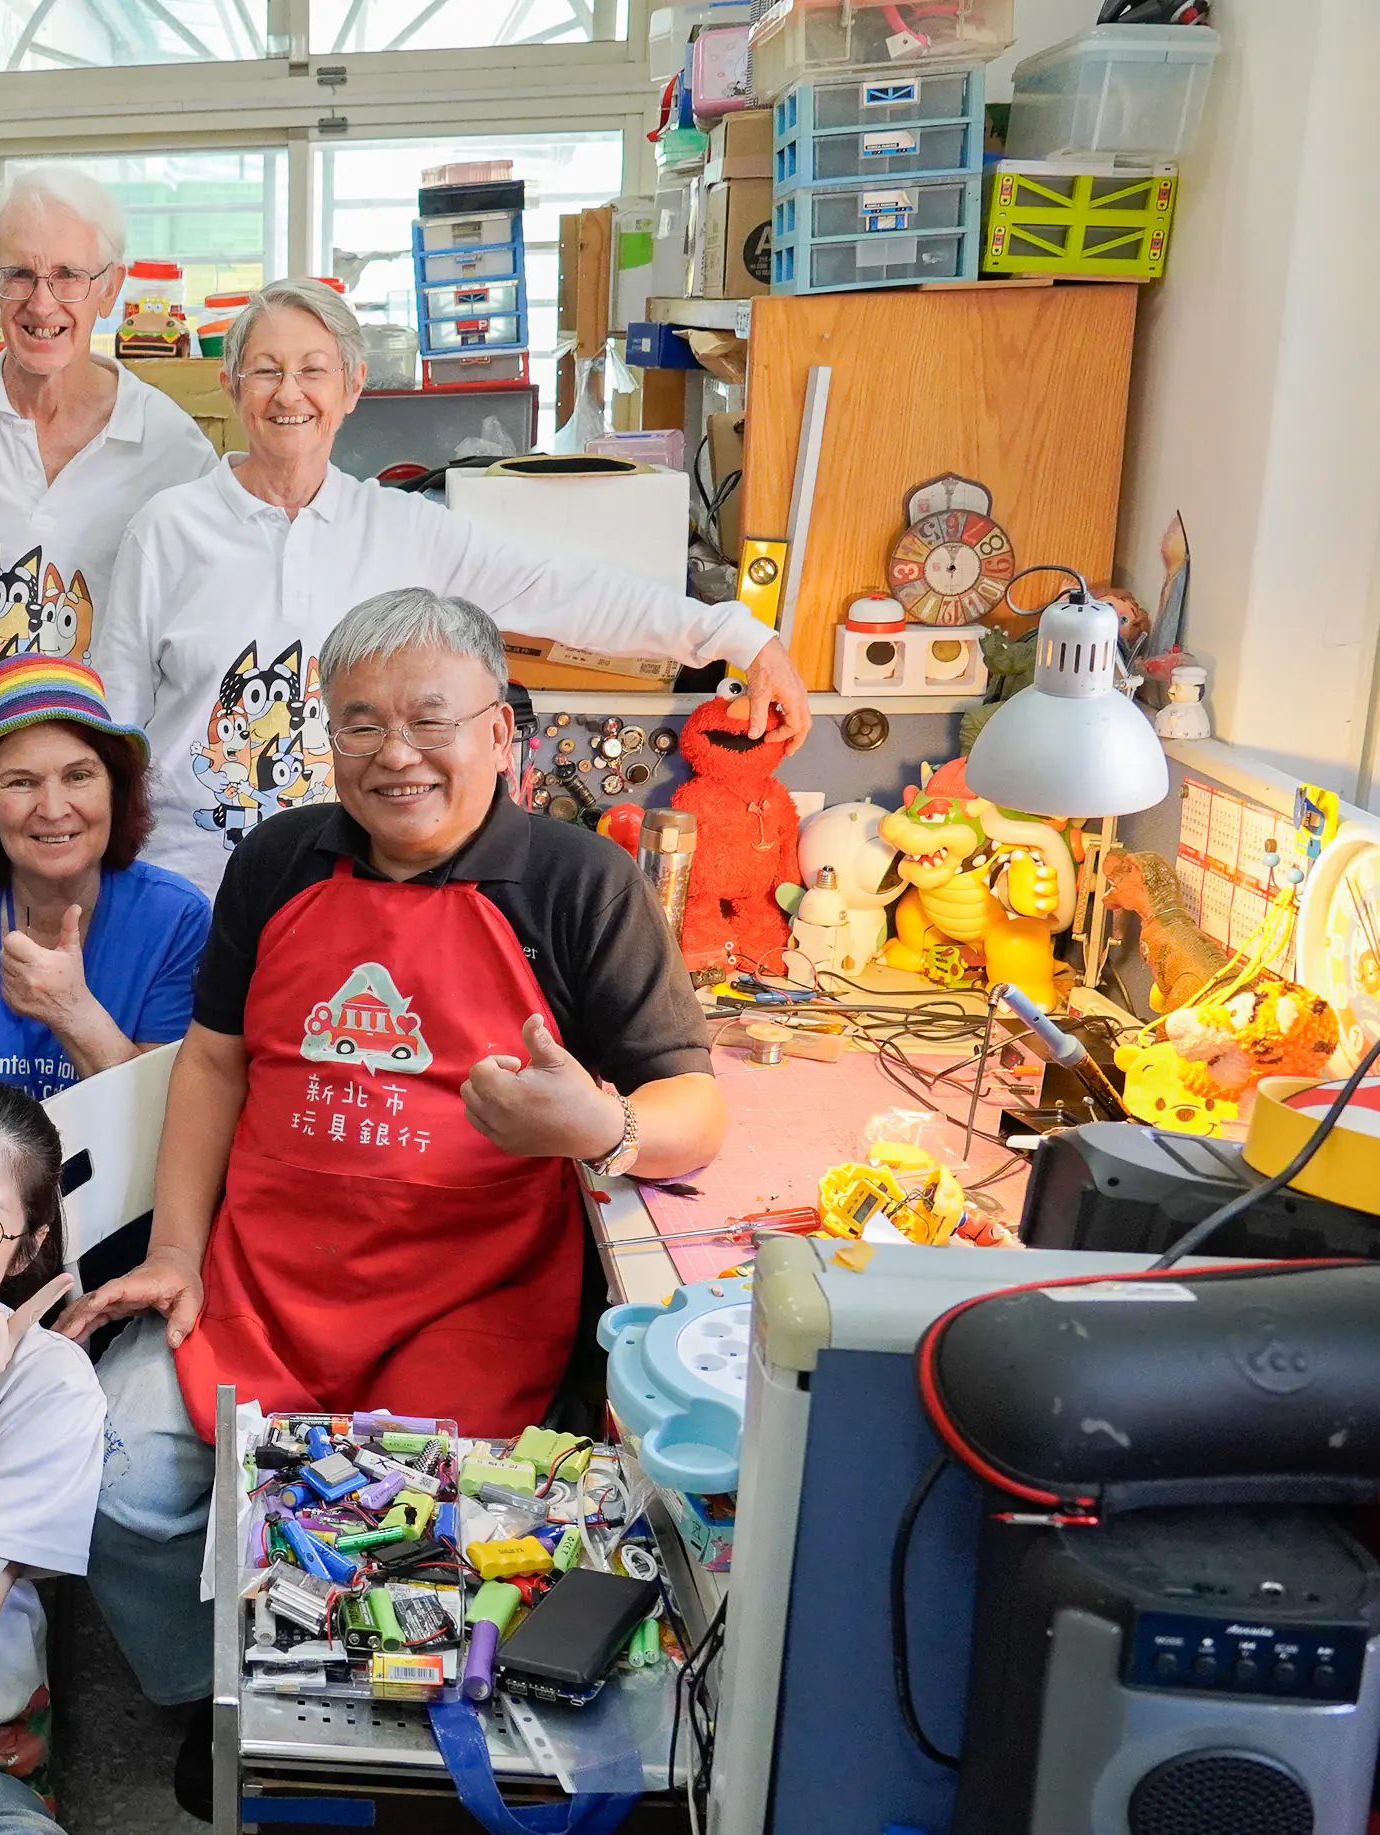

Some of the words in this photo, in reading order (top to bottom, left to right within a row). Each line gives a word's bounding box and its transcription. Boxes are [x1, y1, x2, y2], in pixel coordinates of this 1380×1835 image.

[306, 1073, 407, 1116] 新北市
[291, 1110, 433, 1153] 玩具銀行
